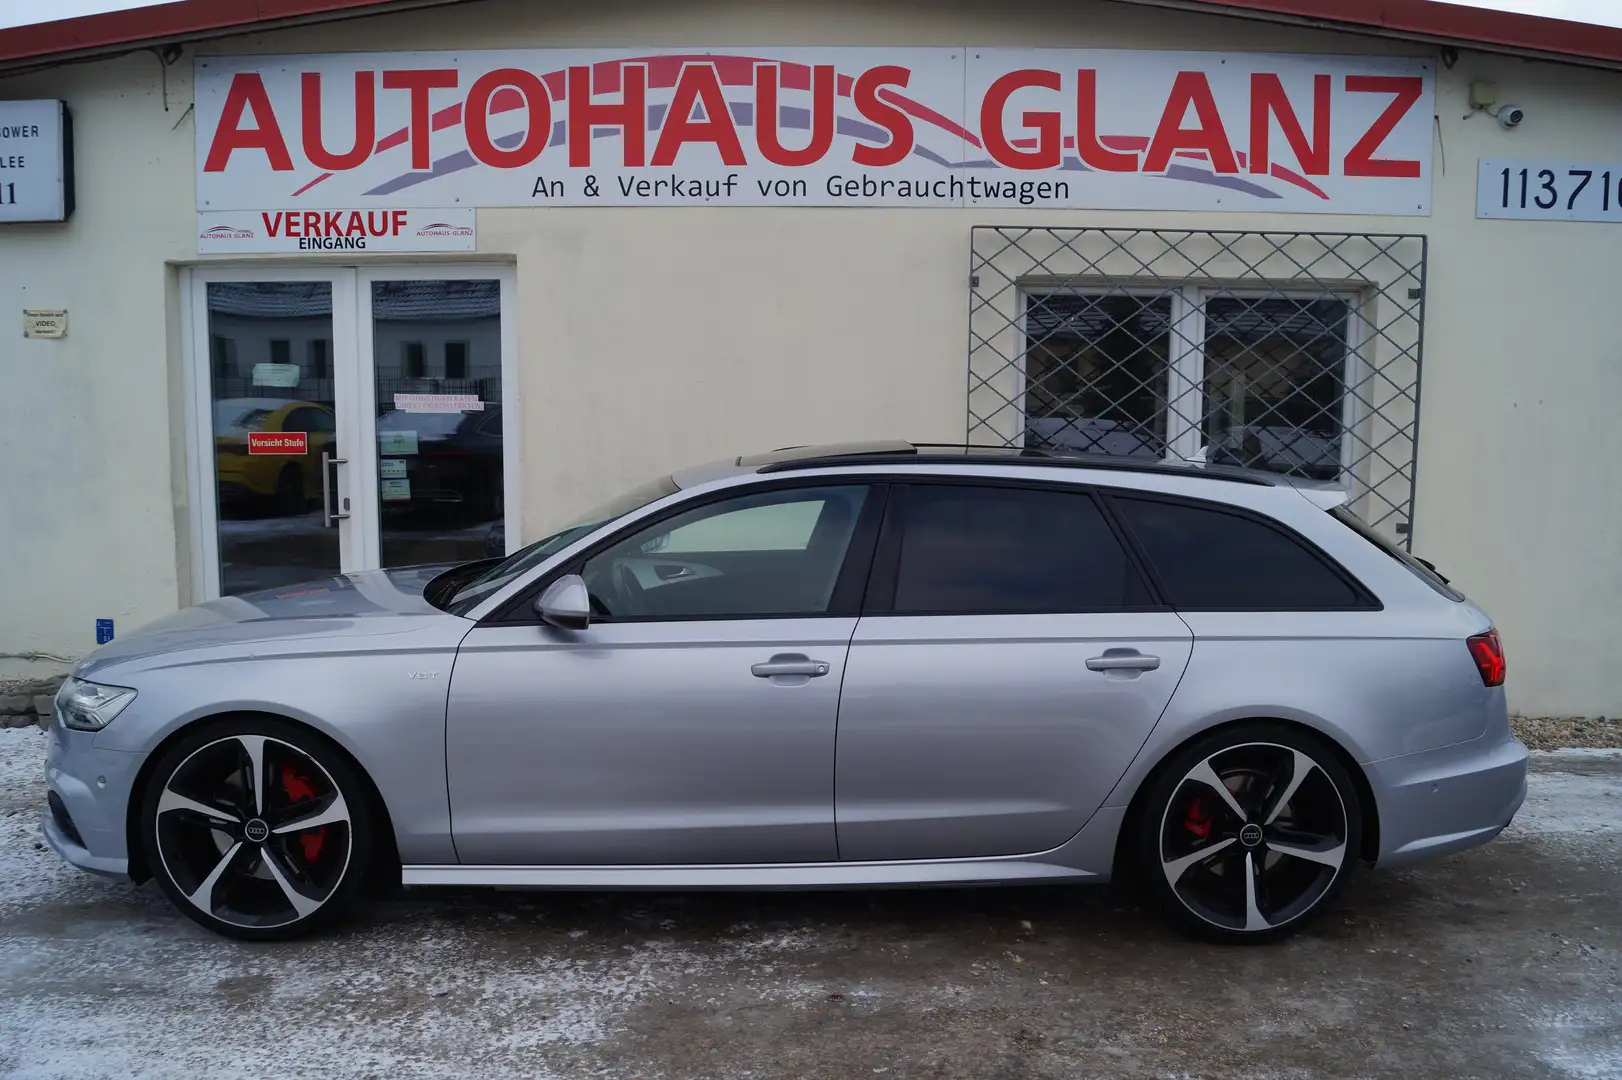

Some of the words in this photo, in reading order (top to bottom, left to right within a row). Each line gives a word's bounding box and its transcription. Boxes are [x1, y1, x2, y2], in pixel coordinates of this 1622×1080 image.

[0, 125, 39, 138] OWER
[203, 62, 914, 173] AUTOHAUS
[979, 68, 1423, 179] GLANZ
[532, 175, 565, 198] An
[583, 175, 600, 197] &
[617, 173, 738, 197] Verkauf
[757, 179, 807, 197] von
[826, 174, 1069, 205] Gebrauchtwagen
[1500, 167, 1622, 212] 11371
[261, 210, 408, 238] VERKAUF
[299, 236, 366, 250] EINGANG
[251, 438, 282, 447] Vorsicht
[284, 438, 305, 447] Stufe
